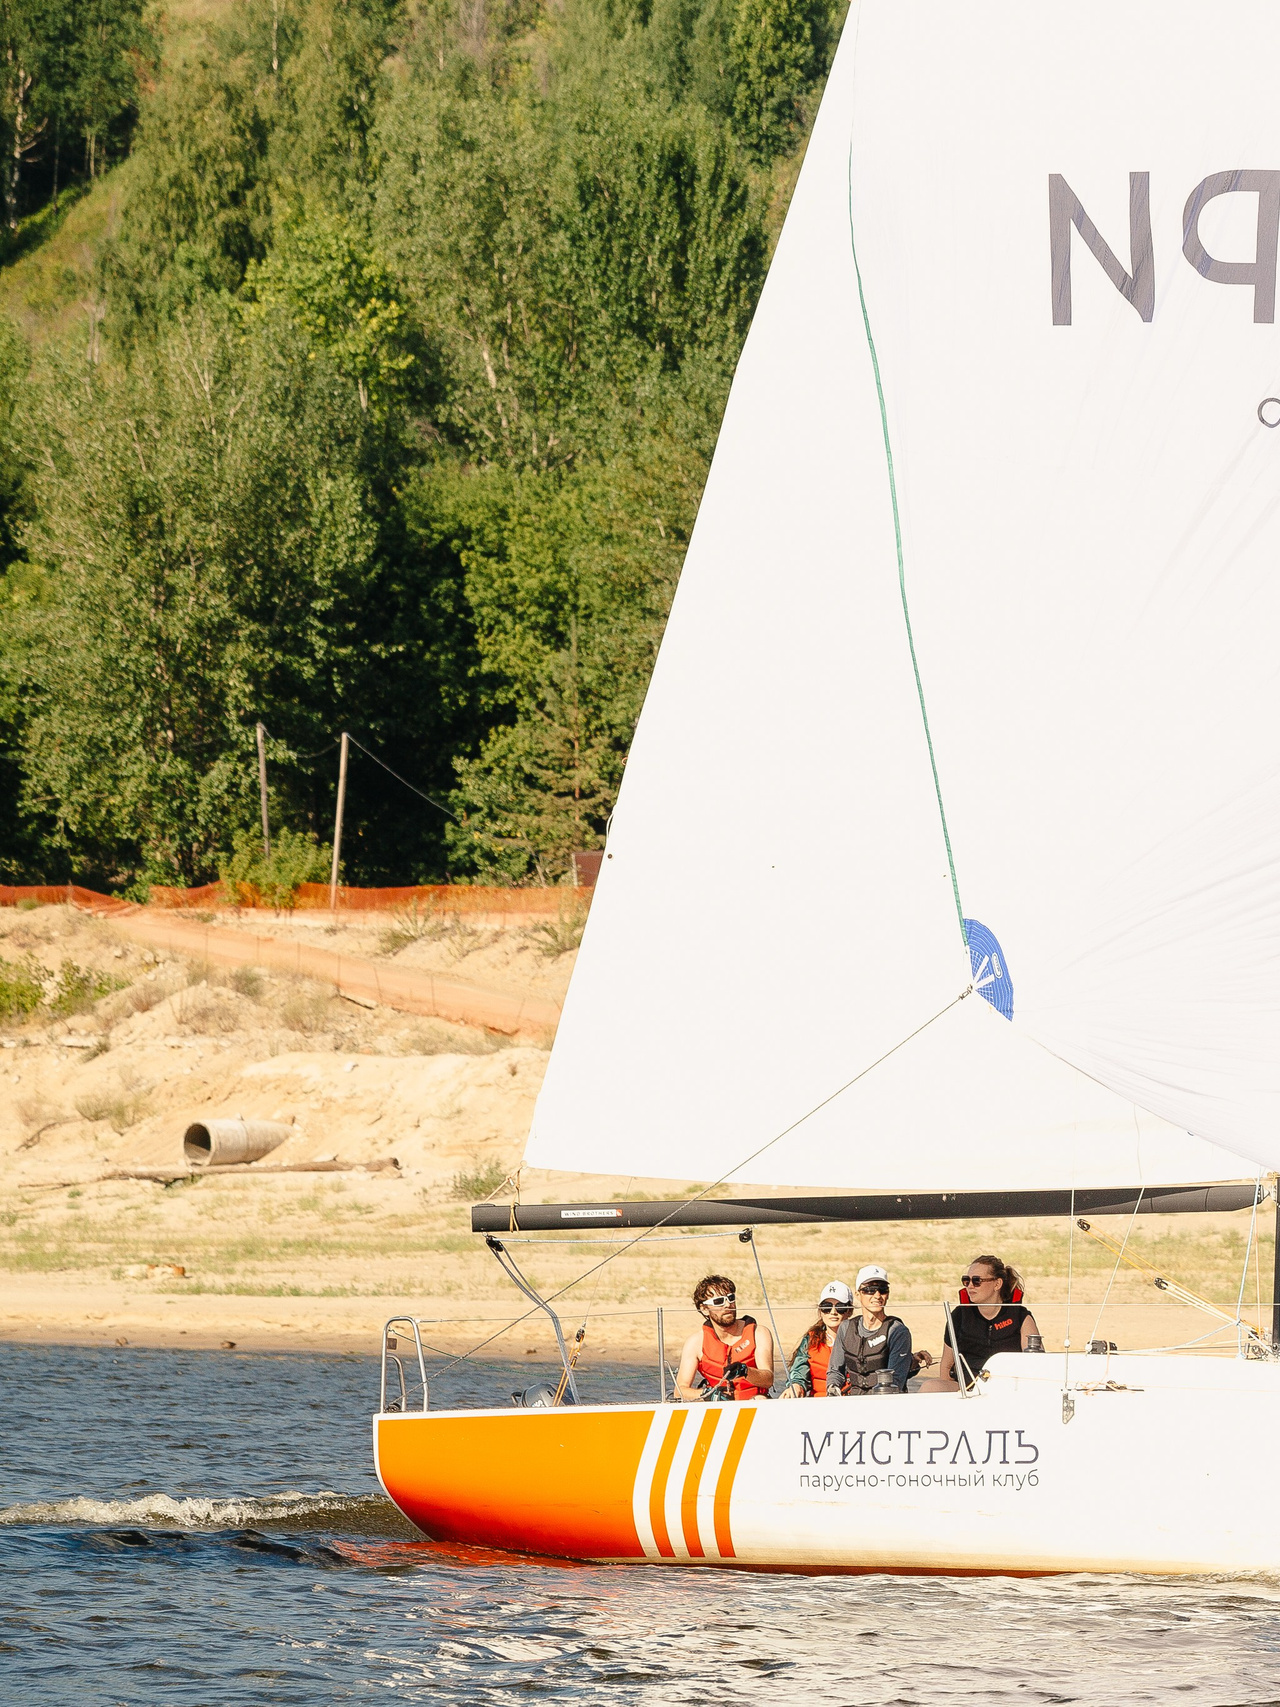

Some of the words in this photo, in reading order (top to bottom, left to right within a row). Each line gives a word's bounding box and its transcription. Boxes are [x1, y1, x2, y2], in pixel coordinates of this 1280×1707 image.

[994, 1318, 1013, 1330] hiko
[799, 1430, 1040, 1466] МИСТРАЛЬ
[799, 1469, 986, 1492] парусно-гоночный
[992, 1468, 1040, 1491] клуб
